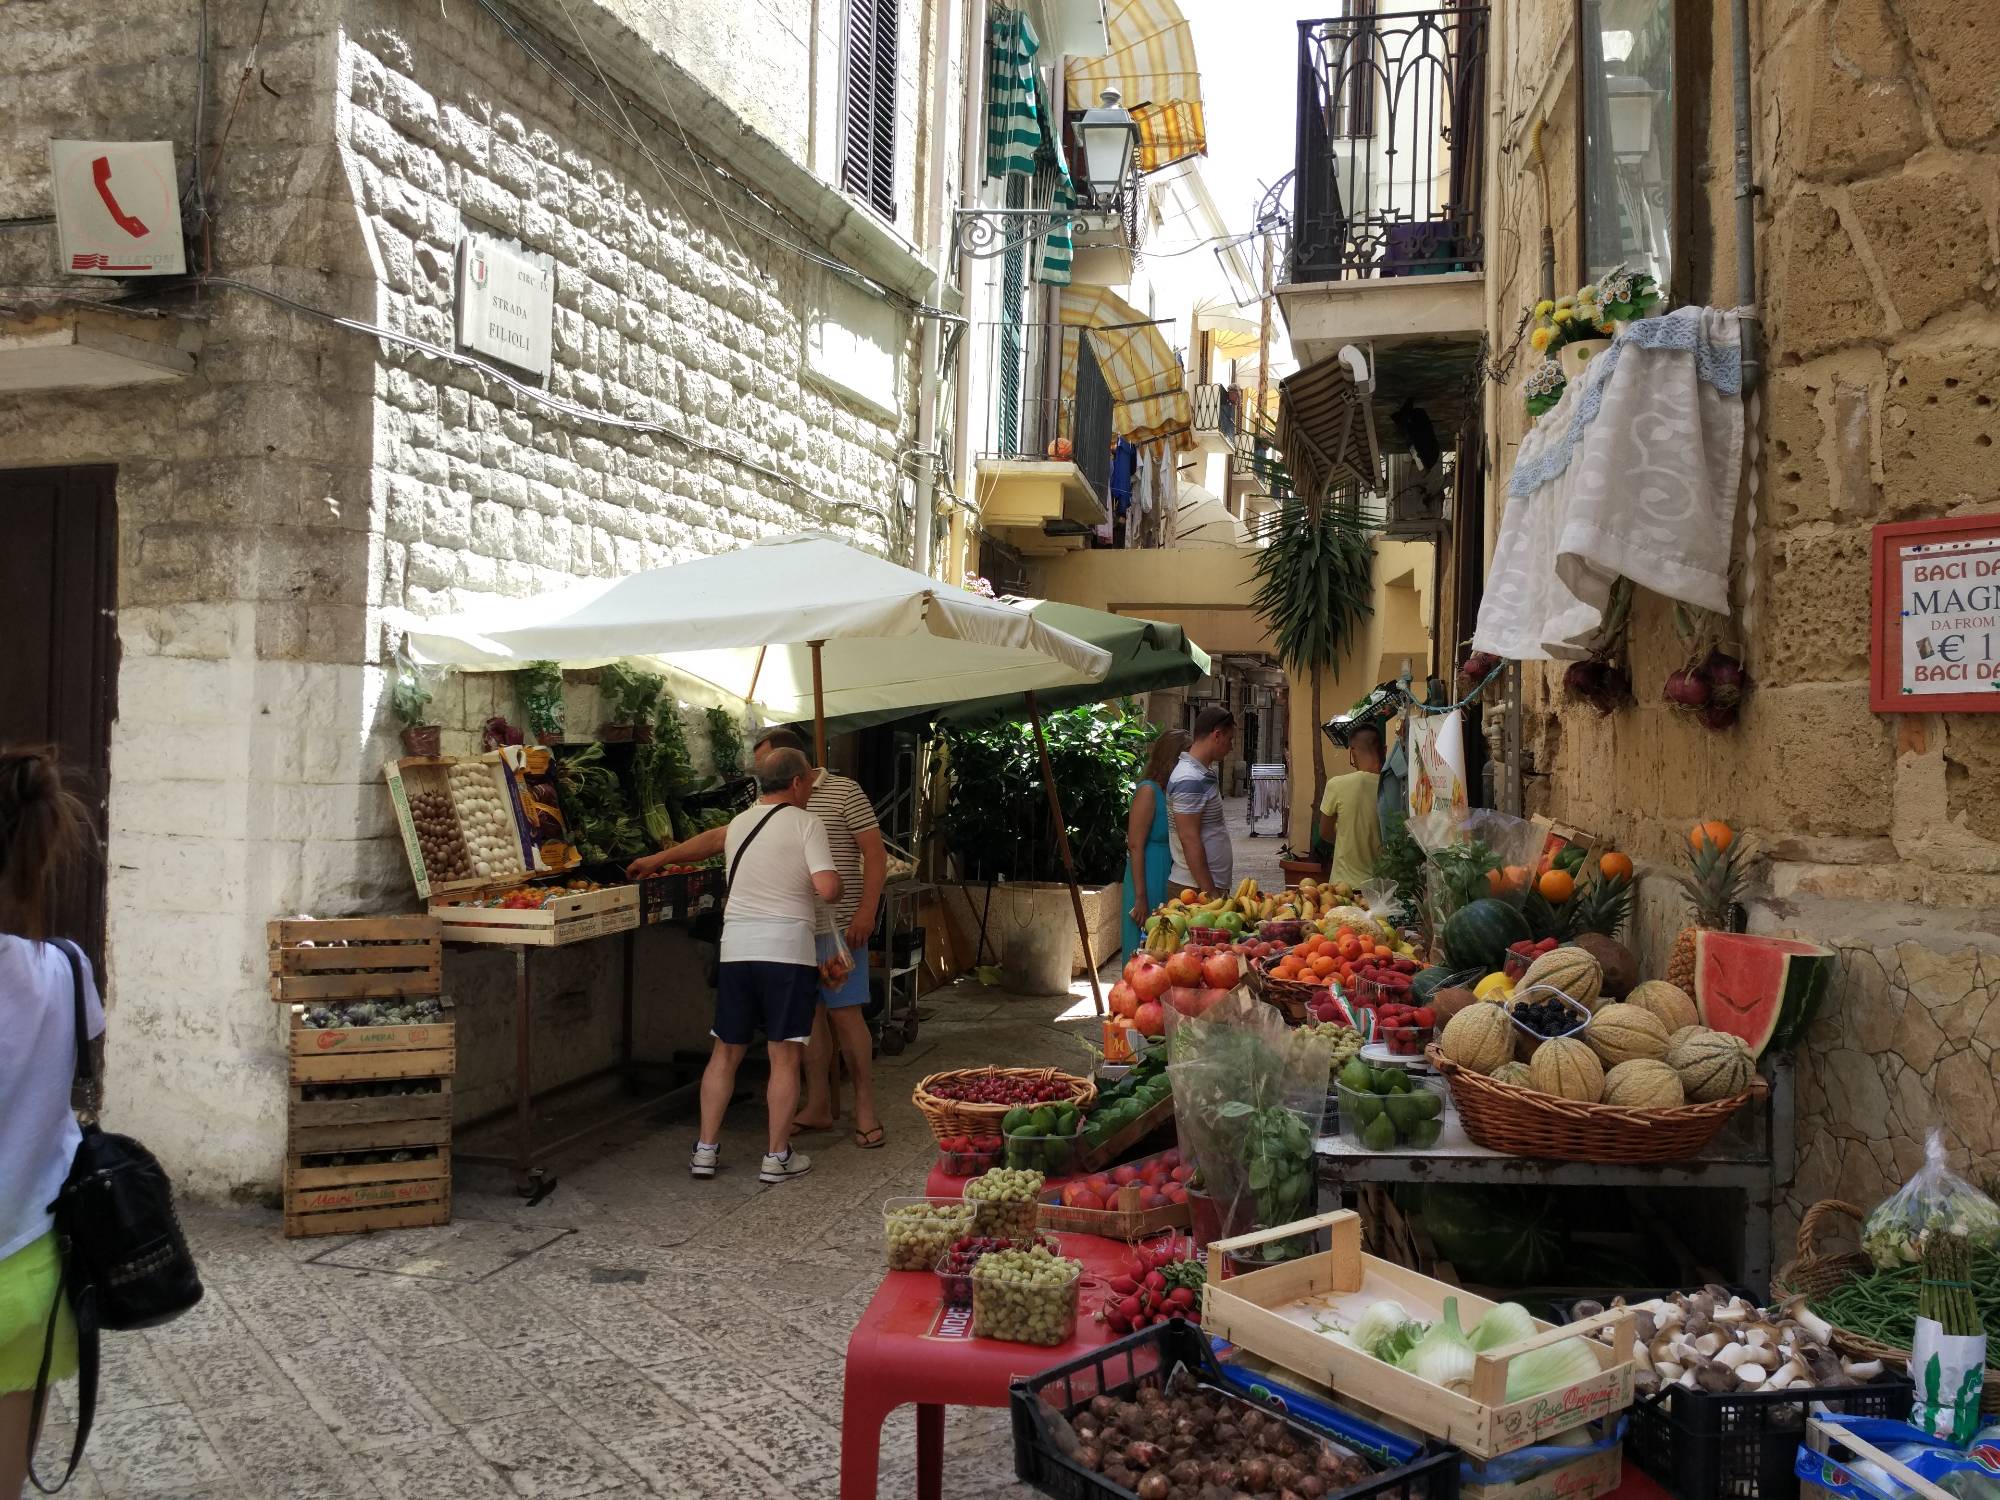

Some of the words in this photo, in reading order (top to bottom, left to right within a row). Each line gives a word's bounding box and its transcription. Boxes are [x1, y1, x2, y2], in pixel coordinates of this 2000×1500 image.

[492, 295, 528, 320] STRADA
[489, 322, 530, 351] FILIOLI
[1914, 562, 1967, 582] BACI
[1931, 620, 1953, 631] DA
[1955, 616, 1995, 630] FROM
[1937, 634, 1966, 663] €
[1914, 663, 1968, 682] BACI
